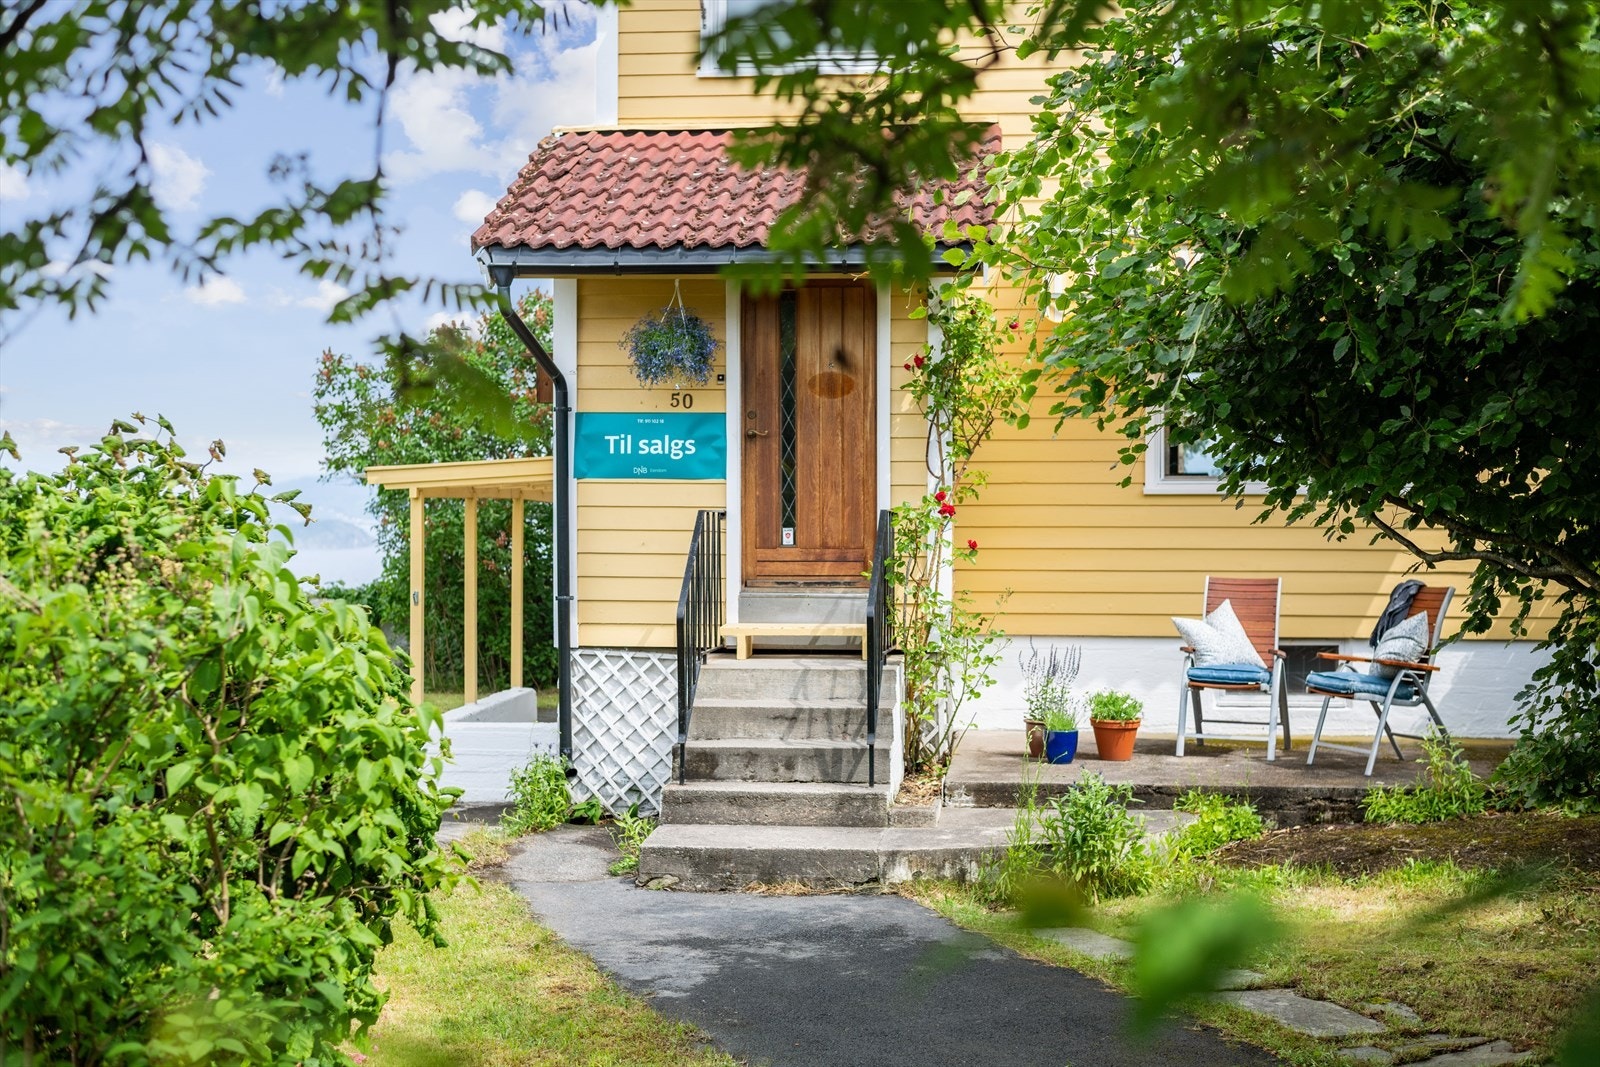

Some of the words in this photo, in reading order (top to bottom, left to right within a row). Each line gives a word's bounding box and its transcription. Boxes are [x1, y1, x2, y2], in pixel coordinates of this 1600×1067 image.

[670, 392, 693, 409] 50
[604, 434, 632, 455] Til
[638, 434, 696, 460] salgs
[633, 466, 648, 475] DNB
